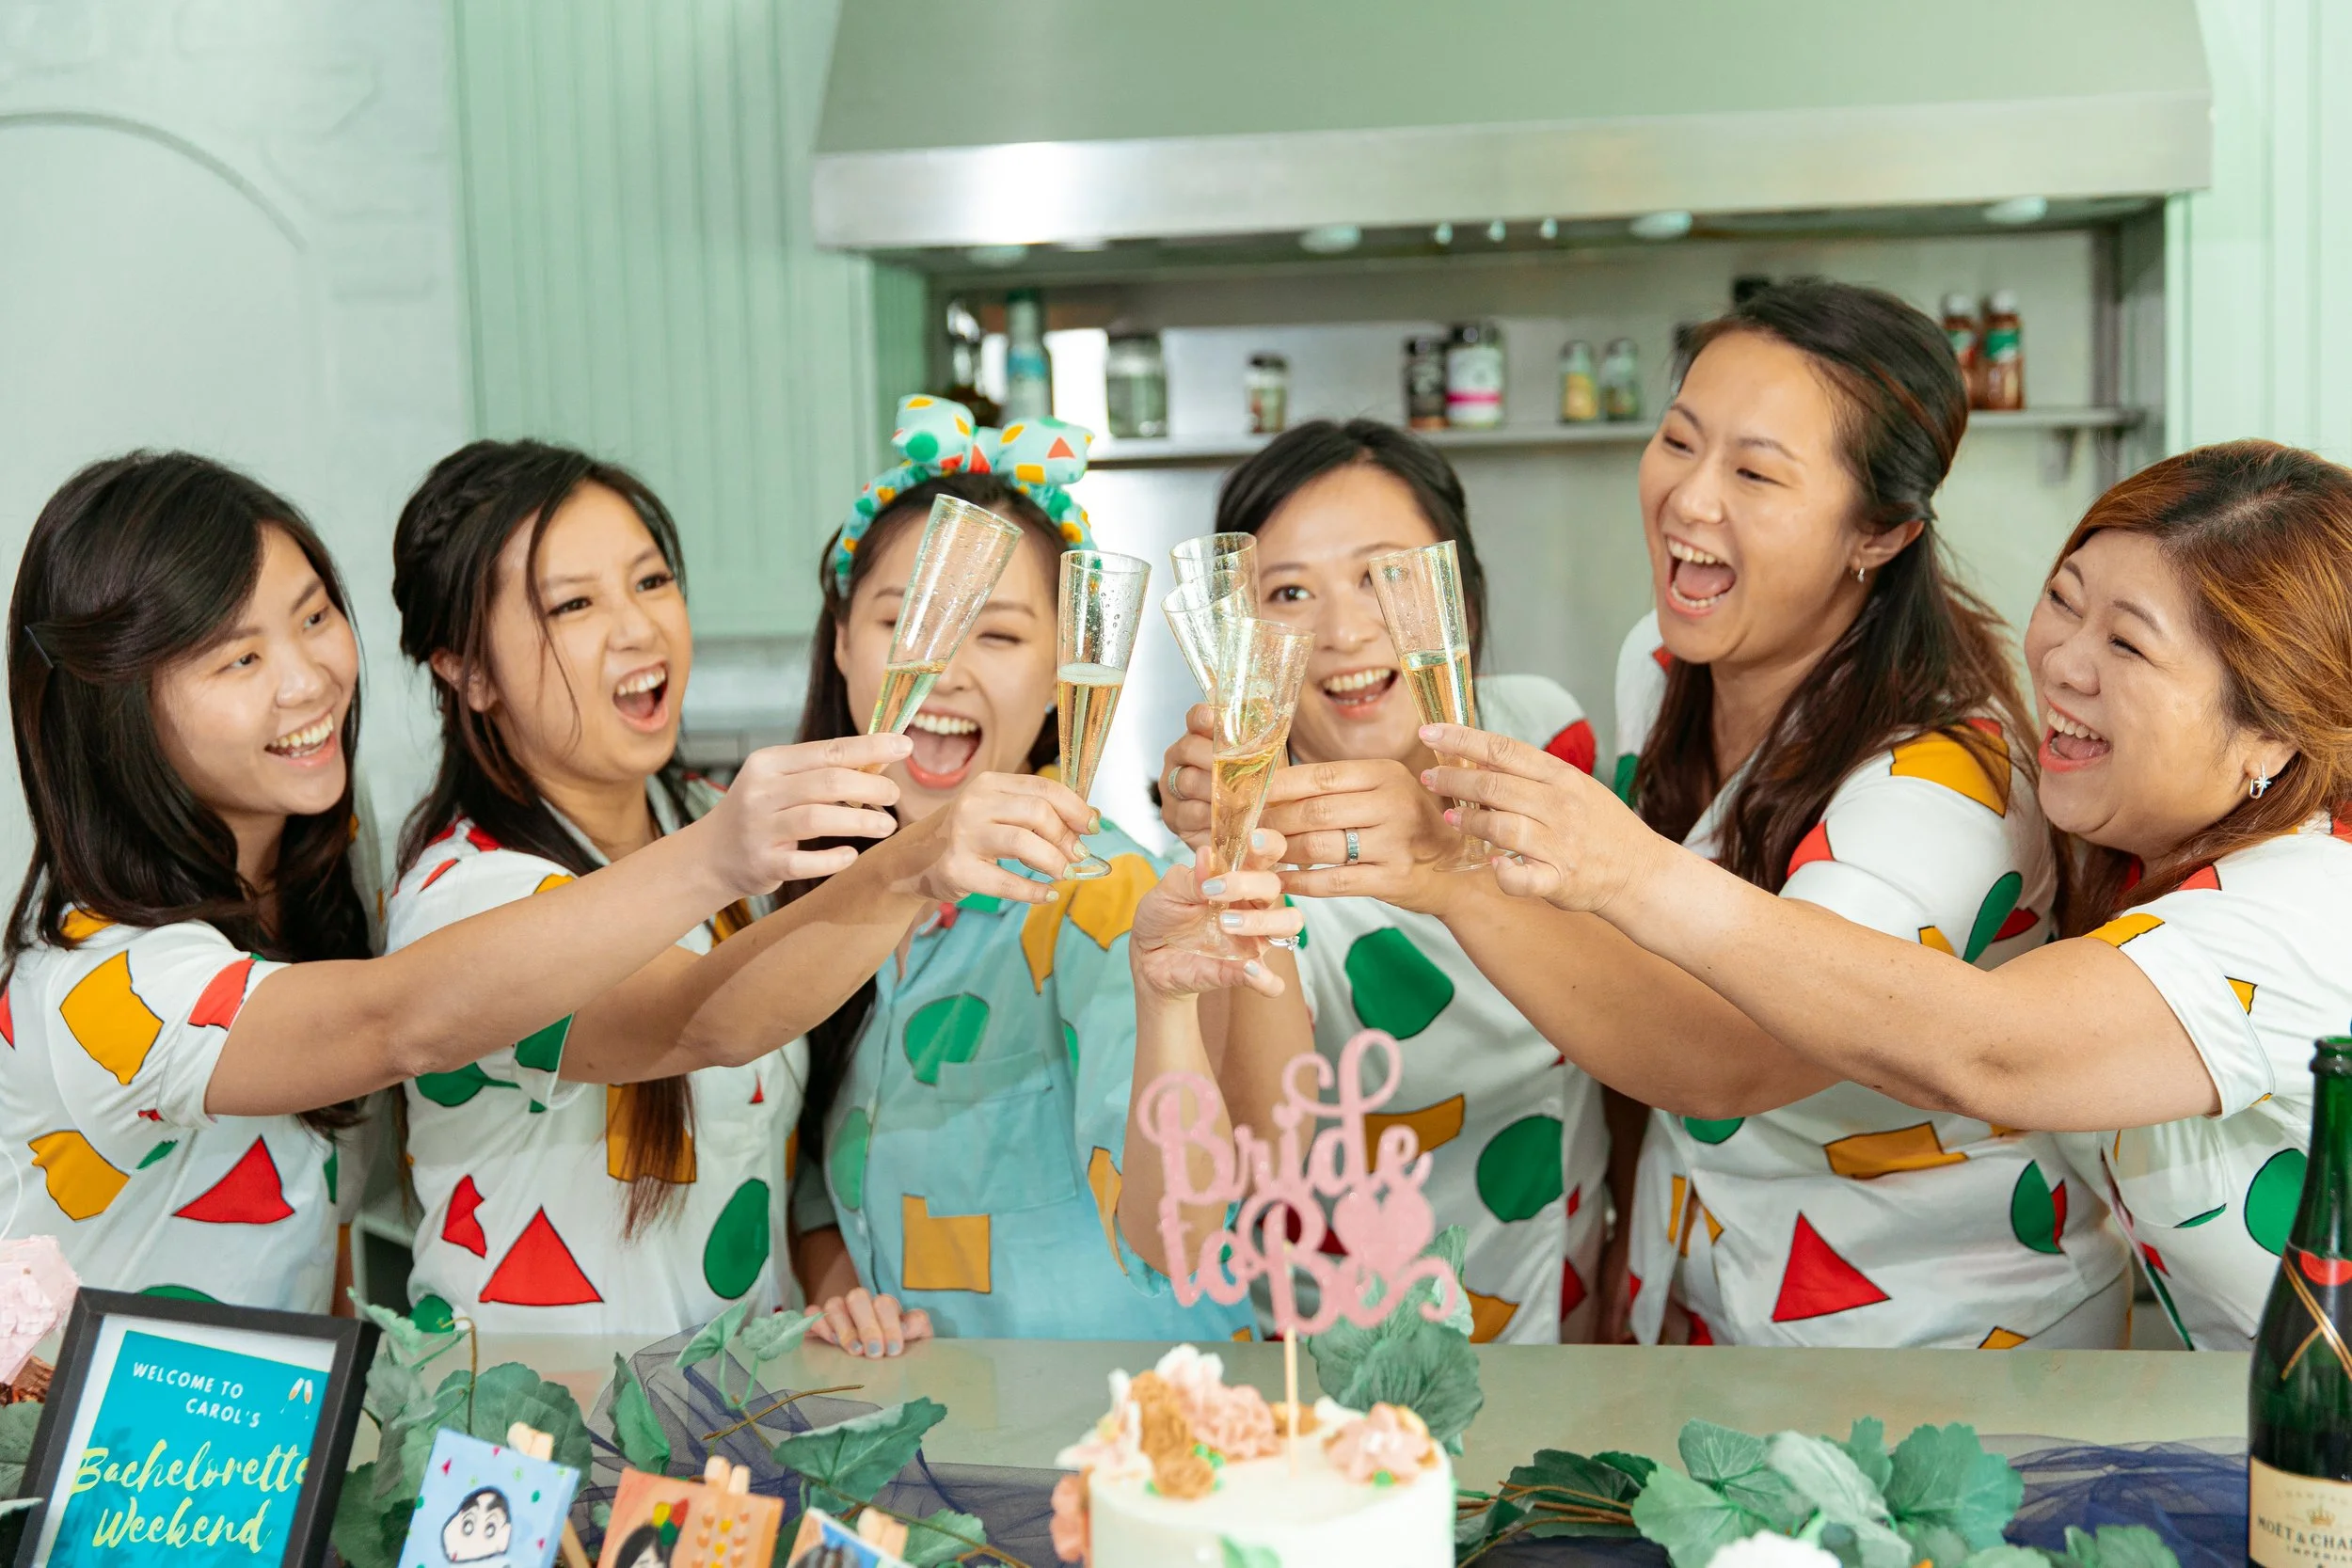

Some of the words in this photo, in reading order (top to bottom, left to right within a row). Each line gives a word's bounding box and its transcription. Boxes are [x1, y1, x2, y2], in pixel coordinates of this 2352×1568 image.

[1136, 1028, 1434, 1206] Bride
[1157, 1195, 1249, 1307] to
[133, 1361, 215, 1393] WELCOME
[222, 1381, 245, 1399] TO
[185, 1398, 262, 1429] CAROL'S
[92, 1497, 273, 1554] Weekend
